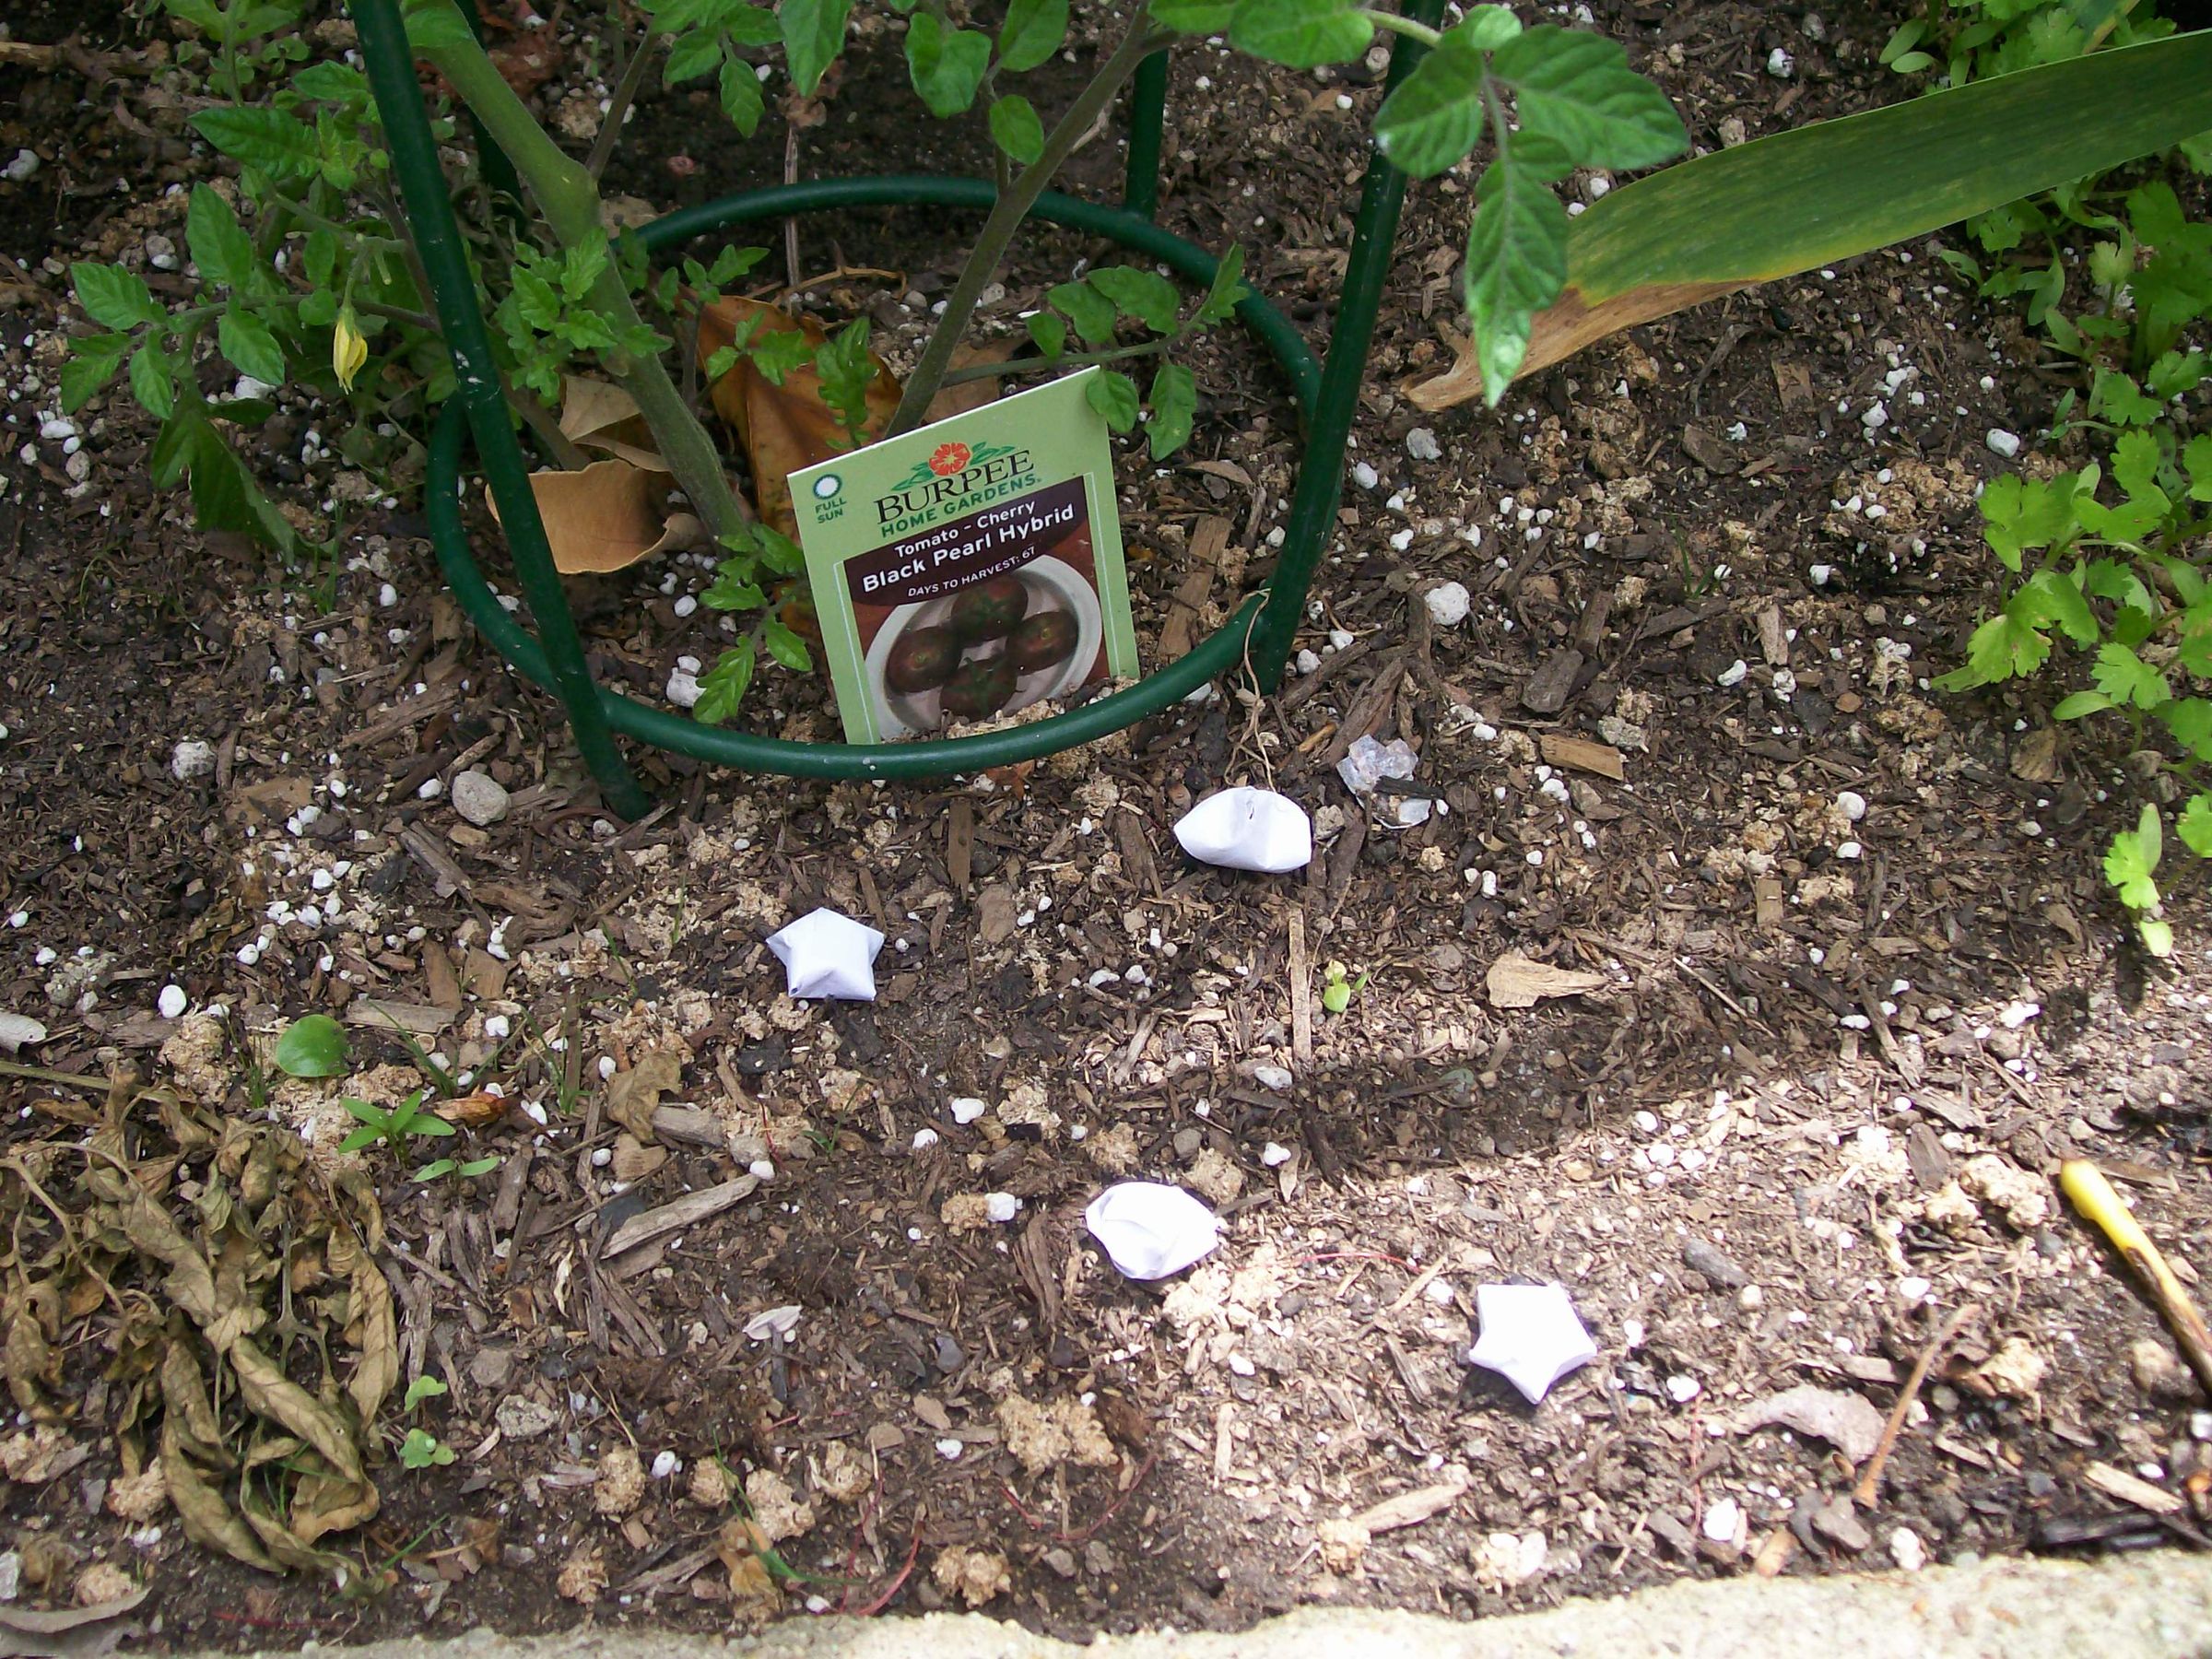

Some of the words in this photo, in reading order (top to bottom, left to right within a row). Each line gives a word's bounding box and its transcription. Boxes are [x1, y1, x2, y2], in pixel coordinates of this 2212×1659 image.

[815, 498, 847, 513] FULL
[874, 450, 1034, 524] BURPEE
[818, 509, 843, 524] SUN
[881, 508, 937, 537] HOME
[895, 527, 959, 558] Tomato
[977, 501, 1035, 528] Cherry
[863, 559, 925, 592] Black
[934, 533, 991, 567] Pearl
[999, 503, 1074, 543] Hybrid
[908, 583, 939, 596] DAYS
[943, 579, 959, 590] TO
[961, 556, 1020, 584] HARVEST:
[1022, 546, 1035, 559] 67
